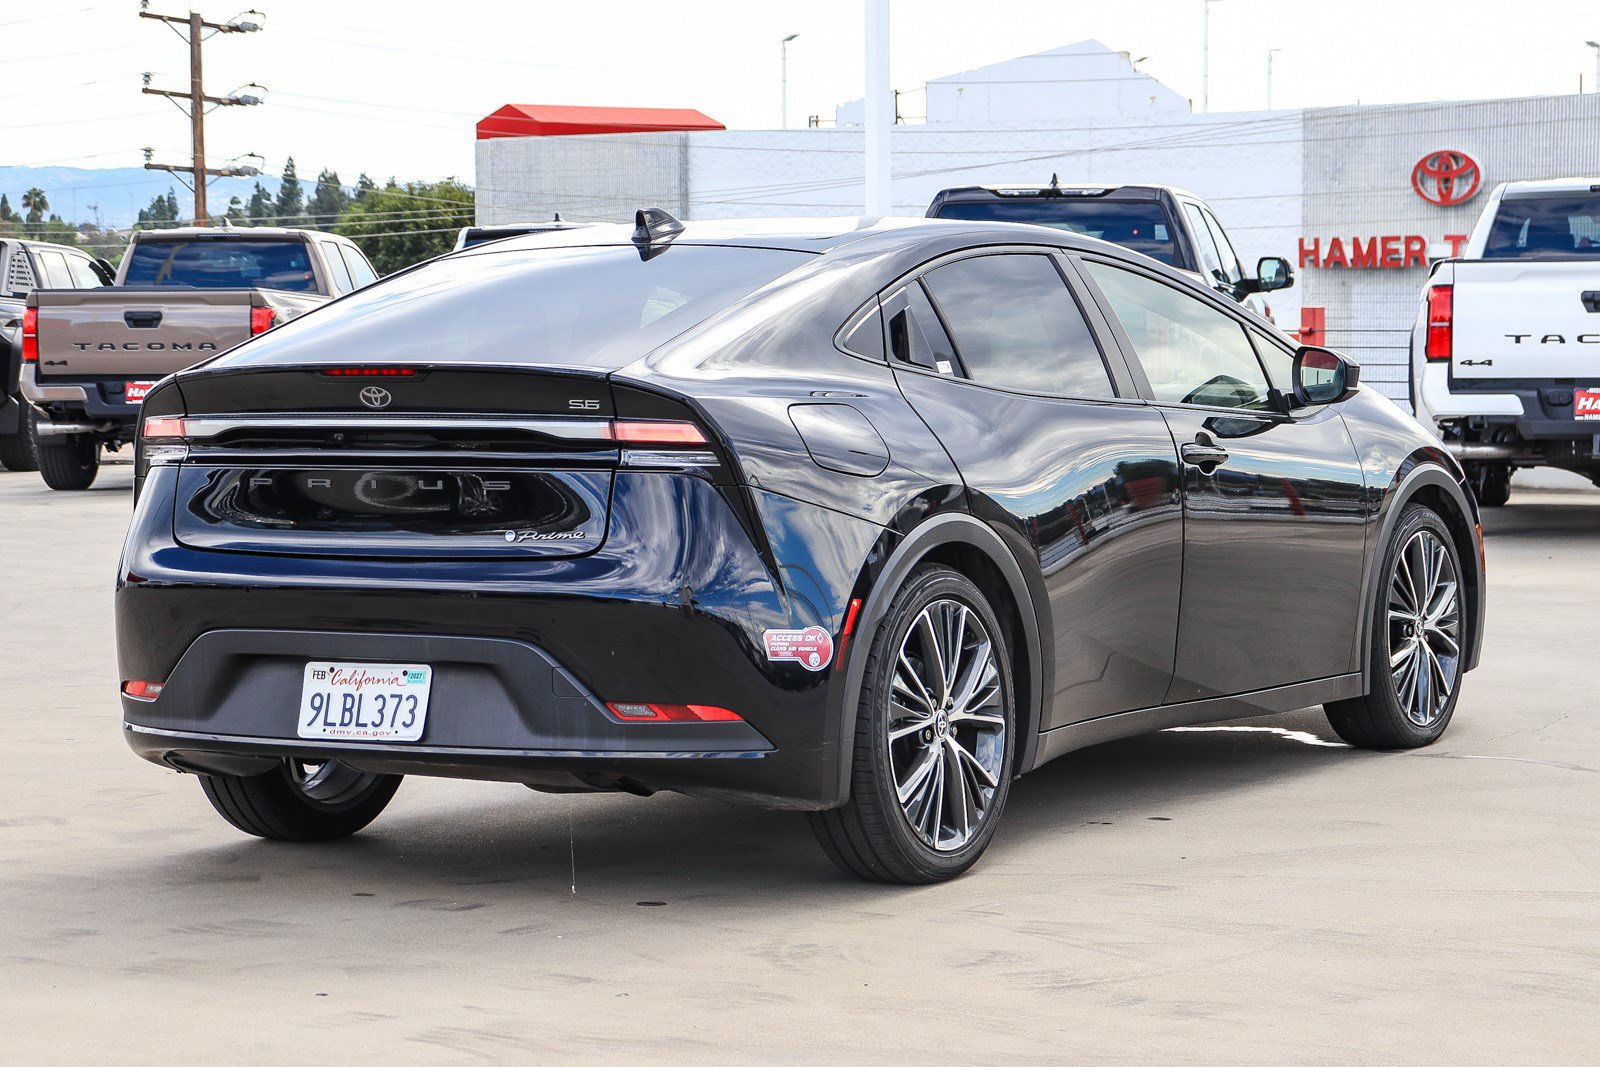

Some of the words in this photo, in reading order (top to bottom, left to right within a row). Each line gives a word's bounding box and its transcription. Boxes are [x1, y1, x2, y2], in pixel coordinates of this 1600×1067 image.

[1298, 235, 1428, 268] HAMER
[73, 342, 217, 352] TACOMA
[250, 477, 511, 491] PRIUS
[517, 530, 586, 542] Prime
[770, 634, 803, 642] ACCESS
[804, 634, 817, 642] OK
[312, 670, 326, 680] FEB
[329, 668, 407, 691] California
[306, 692, 418, 728] 9LBL373
[329, 729, 392, 737] dmv.ca.gov
